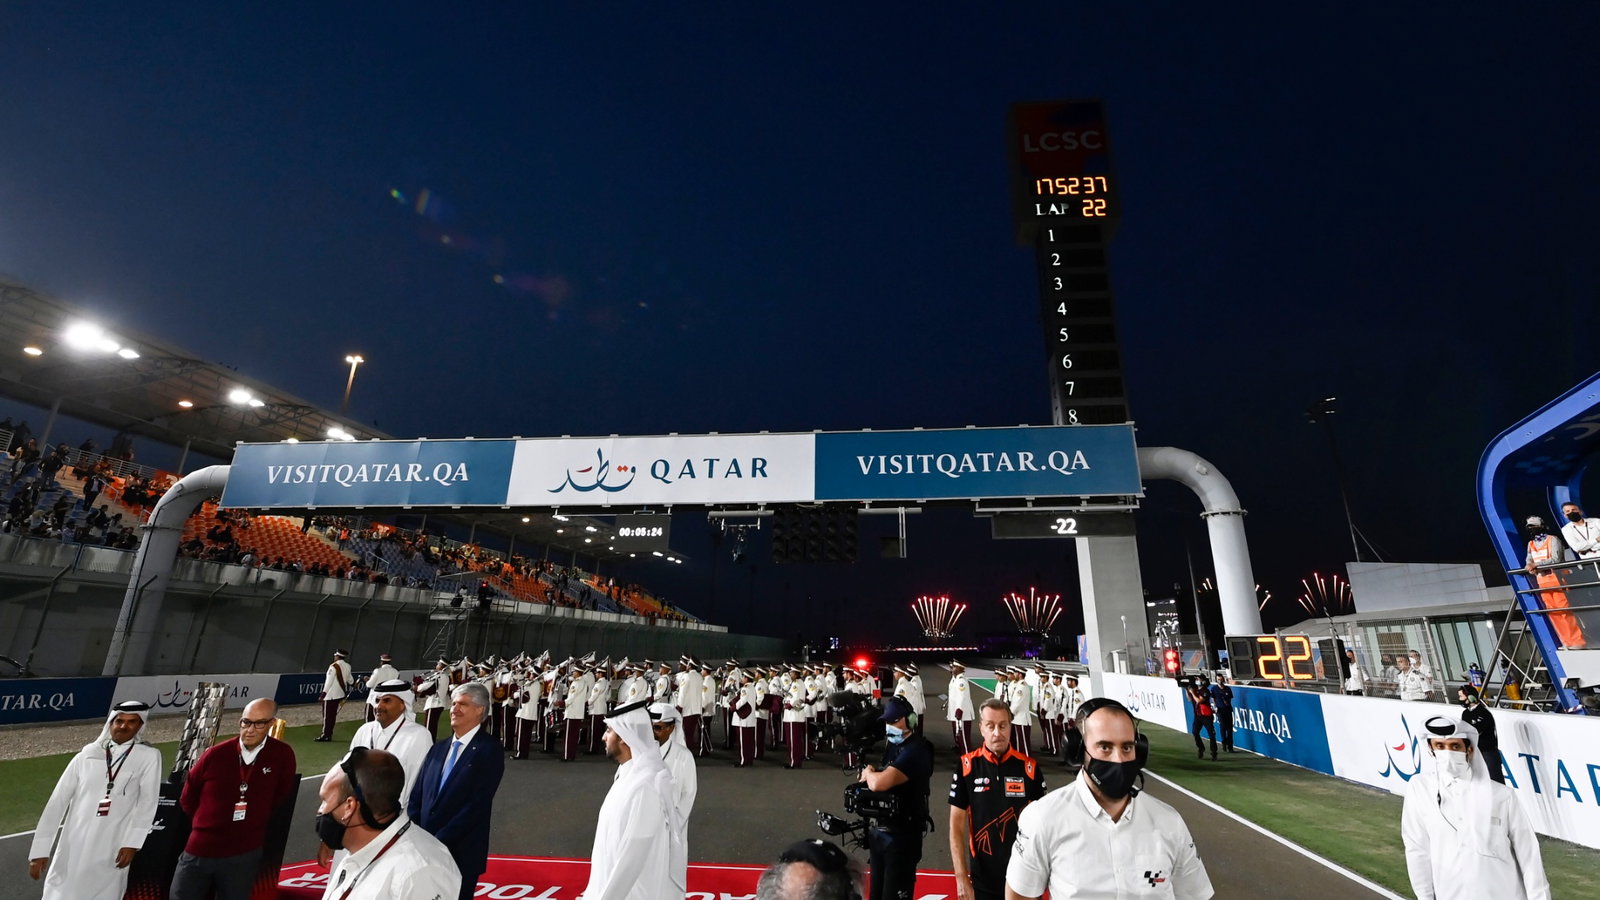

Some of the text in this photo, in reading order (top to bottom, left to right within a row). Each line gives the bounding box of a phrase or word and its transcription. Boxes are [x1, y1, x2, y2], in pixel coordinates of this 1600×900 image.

[1023, 130, 1102, 152] LCSC
[1036, 198, 1107, 217] LAP 22
[1049, 229, 1055, 242] 1
[1051, 253, 1061, 266] 2
[1054, 277, 1063, 290] 3
[1057, 302, 1067, 316] 4
[1059, 328, 1068, 342] 5
[1062, 354, 1072, 369] 6
[1065, 381, 1075, 396] 7
[1068, 409, 1078, 425] 8
[650, 457, 768, 484] QATAR
[857, 450, 1091, 478] VISITQATAR.QA
[267, 462, 469, 487] VISITQATAR.QA
[618, 527, 663, 537] 00:05:24
[1050, 518, 1078, 534] -22
[1257, 636, 1313, 680] 22
[1140, 691, 1167, 711] QATAR
